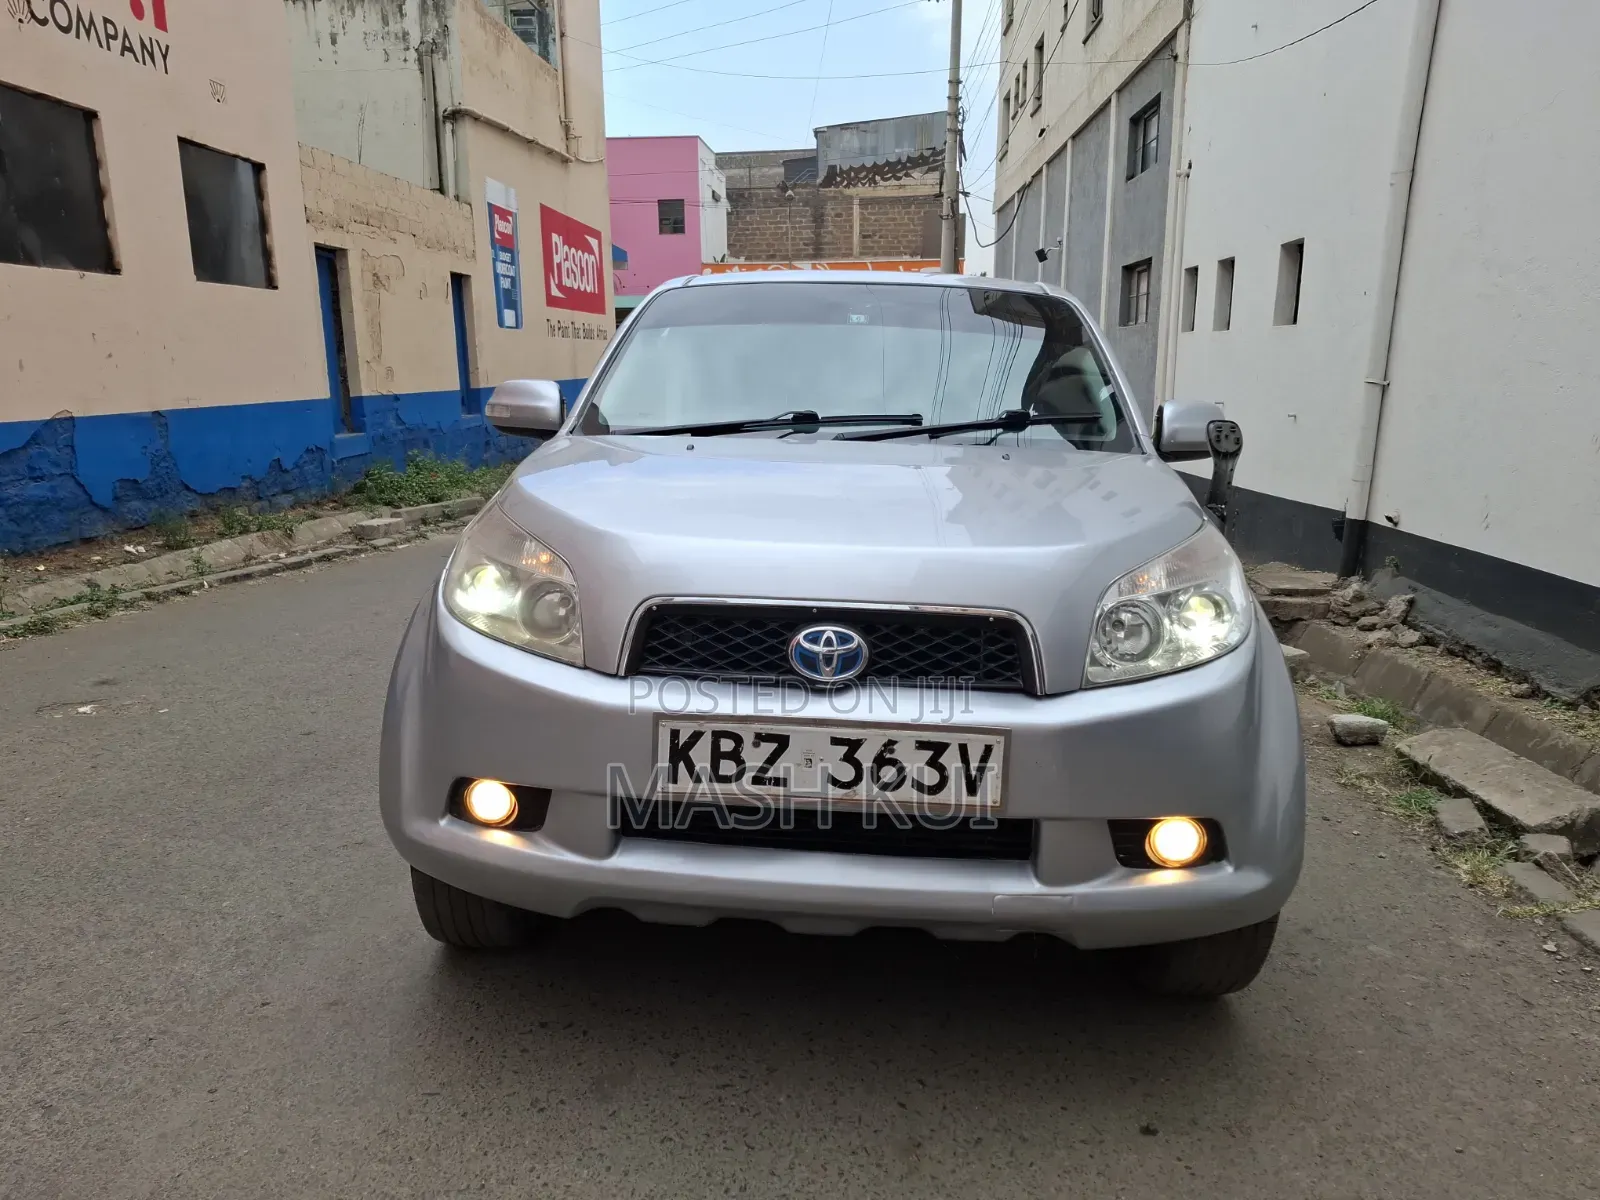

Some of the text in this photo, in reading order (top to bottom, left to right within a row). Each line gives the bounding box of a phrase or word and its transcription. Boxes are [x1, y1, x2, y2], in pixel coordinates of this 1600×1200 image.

[27, 0, 170, 75] COMPANY
[494, 213, 513, 235] Plascon
[551, 232, 599, 294] Plascon
[546, 318, 608, 341] The Paint That Builds Africa
[668, 728, 994, 798] KBZ 363V
